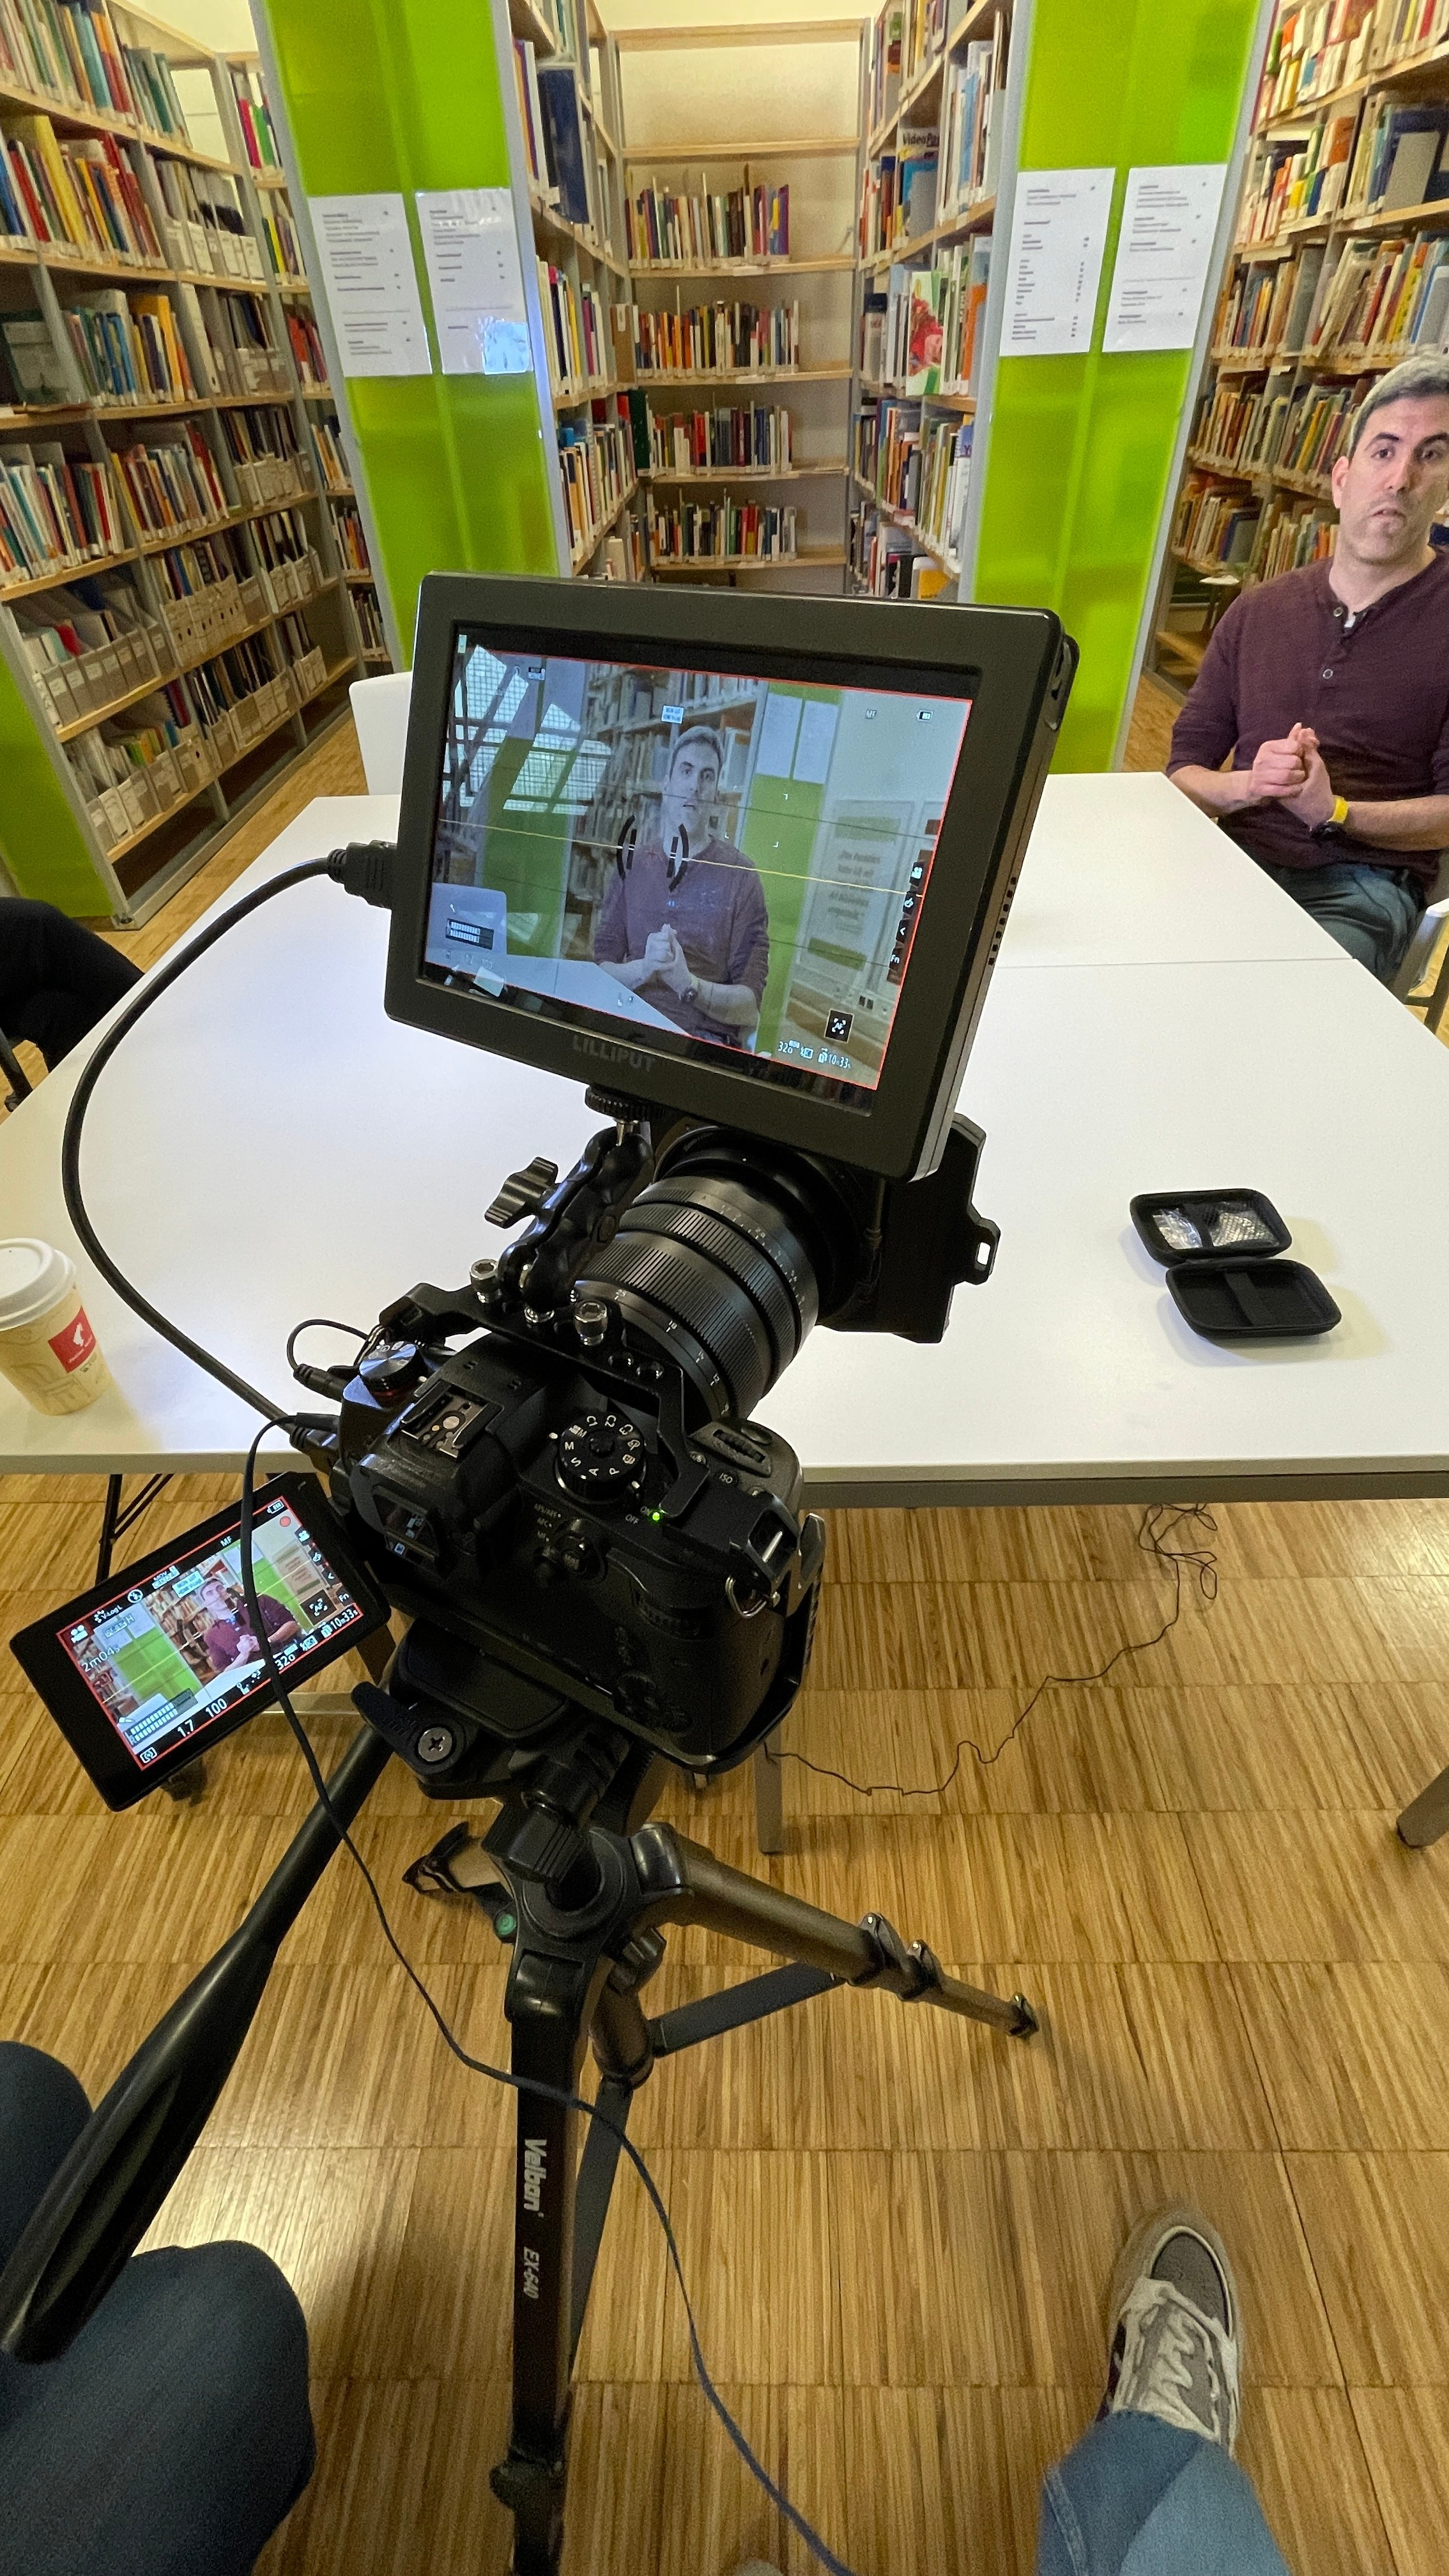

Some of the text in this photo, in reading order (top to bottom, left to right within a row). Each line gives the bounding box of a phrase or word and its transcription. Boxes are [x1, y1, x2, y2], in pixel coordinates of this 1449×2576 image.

[573, 1034, 656, 1073] LILLIPUT
[604, 1415, 617, 1427] C2
[619, 1424, 634, 1435] C3
[565, 1441, 574, 1450] M
[571, 1457, 581, 1467] S
[588, 1468, 599, 1476] A
[719, 1473, 733, 1484] ISO
[625, 1514, 639, 1524] OFF
[220, 1536, 232, 1547] MF
[338, 1593, 349, 1602] Fn
[82, 1644, 120, 1672] 2m04s
[205, 1698, 227, 1718] 100
[177, 1719, 194, 1737] 1.7
[524, 2138, 547, 2212] Velbon
[524, 2246, 540, 2299] EX-640
